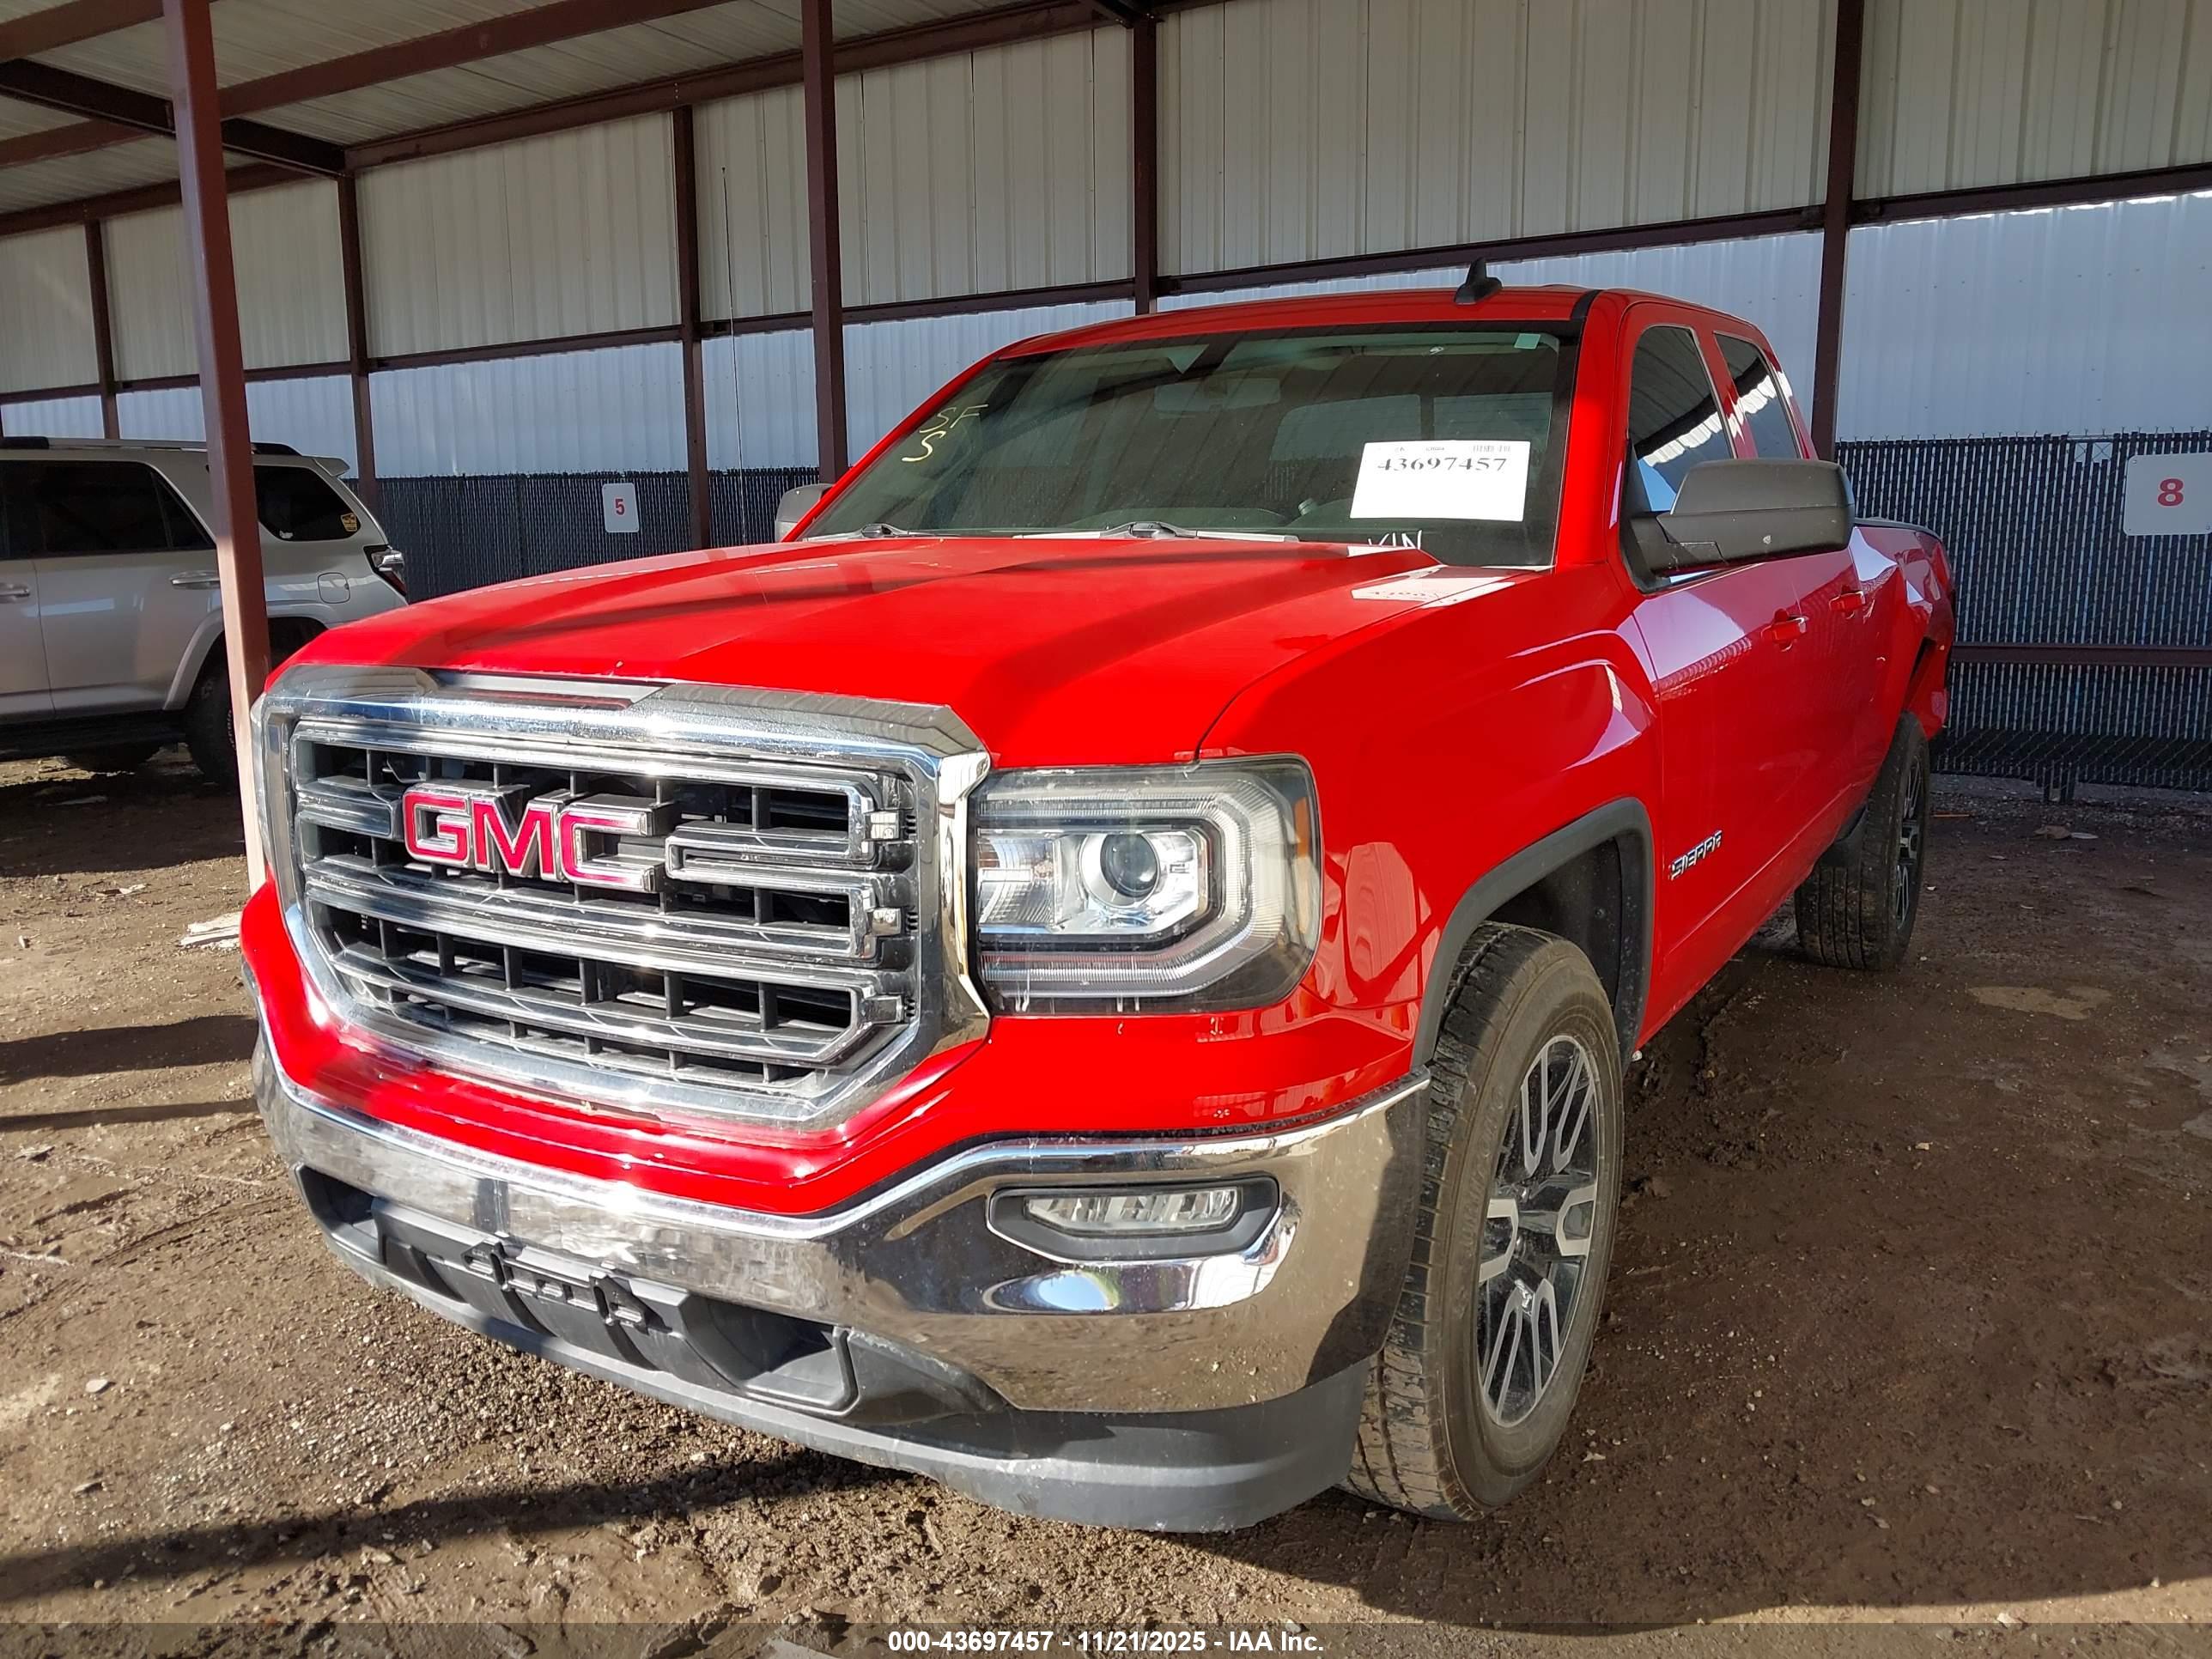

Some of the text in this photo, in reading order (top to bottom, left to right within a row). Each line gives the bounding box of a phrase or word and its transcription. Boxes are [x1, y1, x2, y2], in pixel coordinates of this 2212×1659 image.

[1377, 457, 1507, 472] 43697457
[615, 498, 626, 515] 5
[2157, 478, 2185, 507] 8
[402, 783, 666, 894] GMC
[1670, 830, 1723, 881] SIERRA
